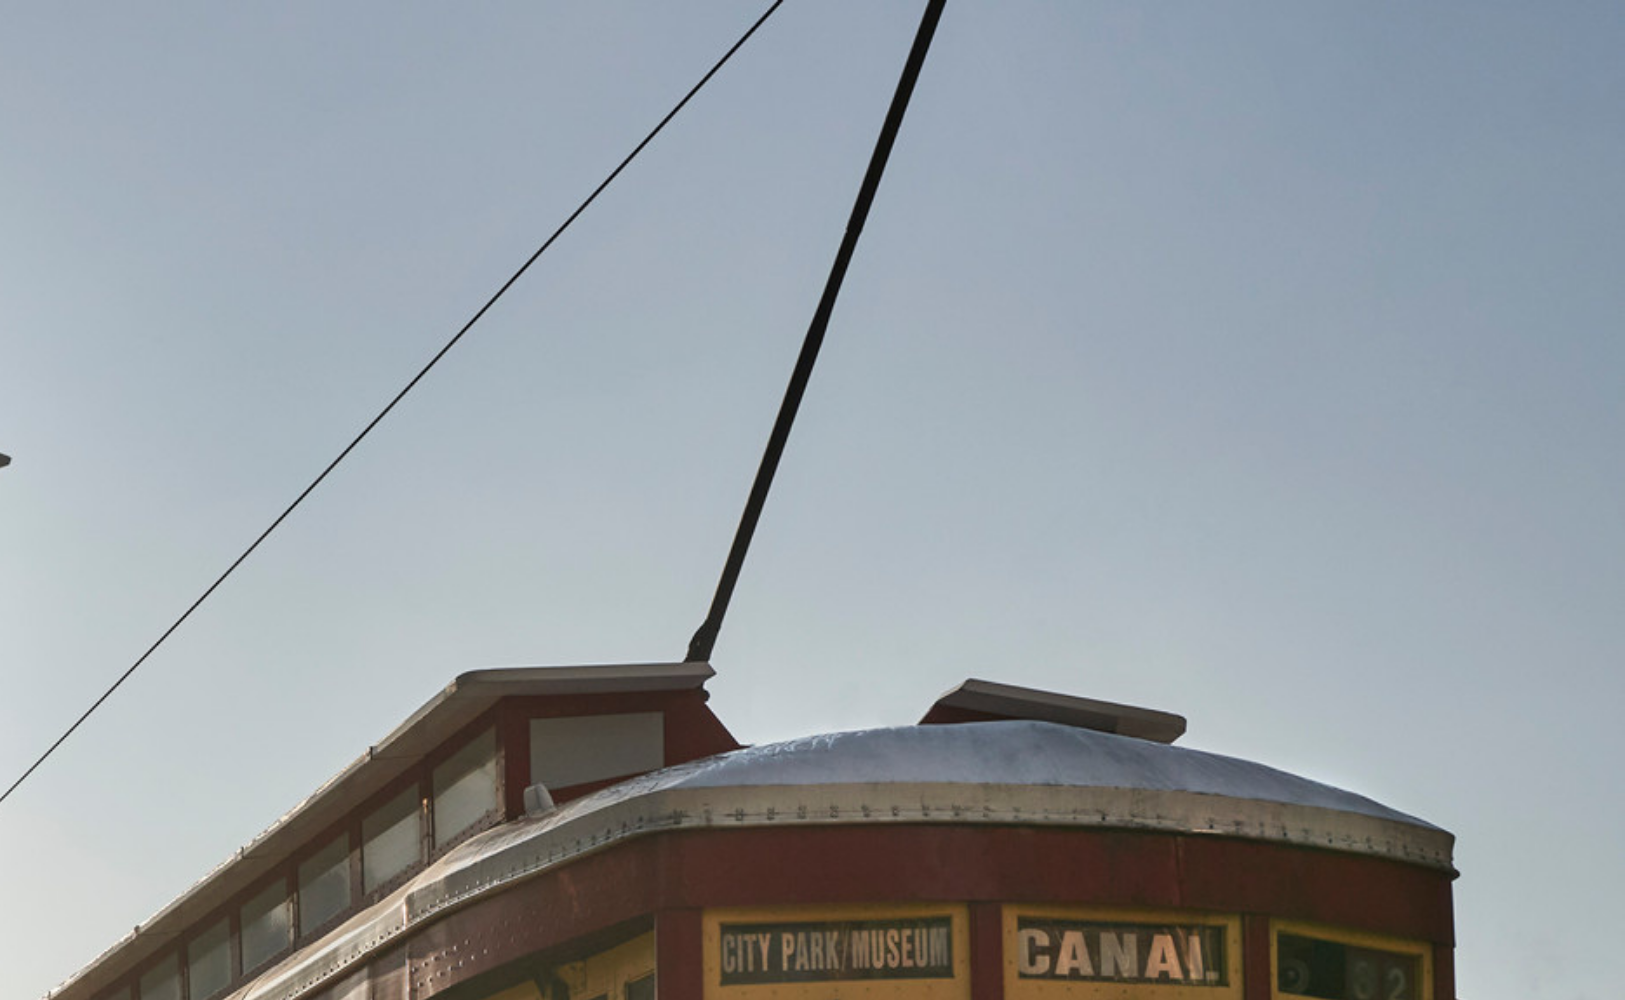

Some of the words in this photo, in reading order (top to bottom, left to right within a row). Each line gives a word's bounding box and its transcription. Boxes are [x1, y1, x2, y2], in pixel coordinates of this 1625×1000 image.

[723, 932, 771, 973] CITY
[781, 927, 949, 972] PARK/MUSEUM
[1017, 928, 1219, 981] CANAL
